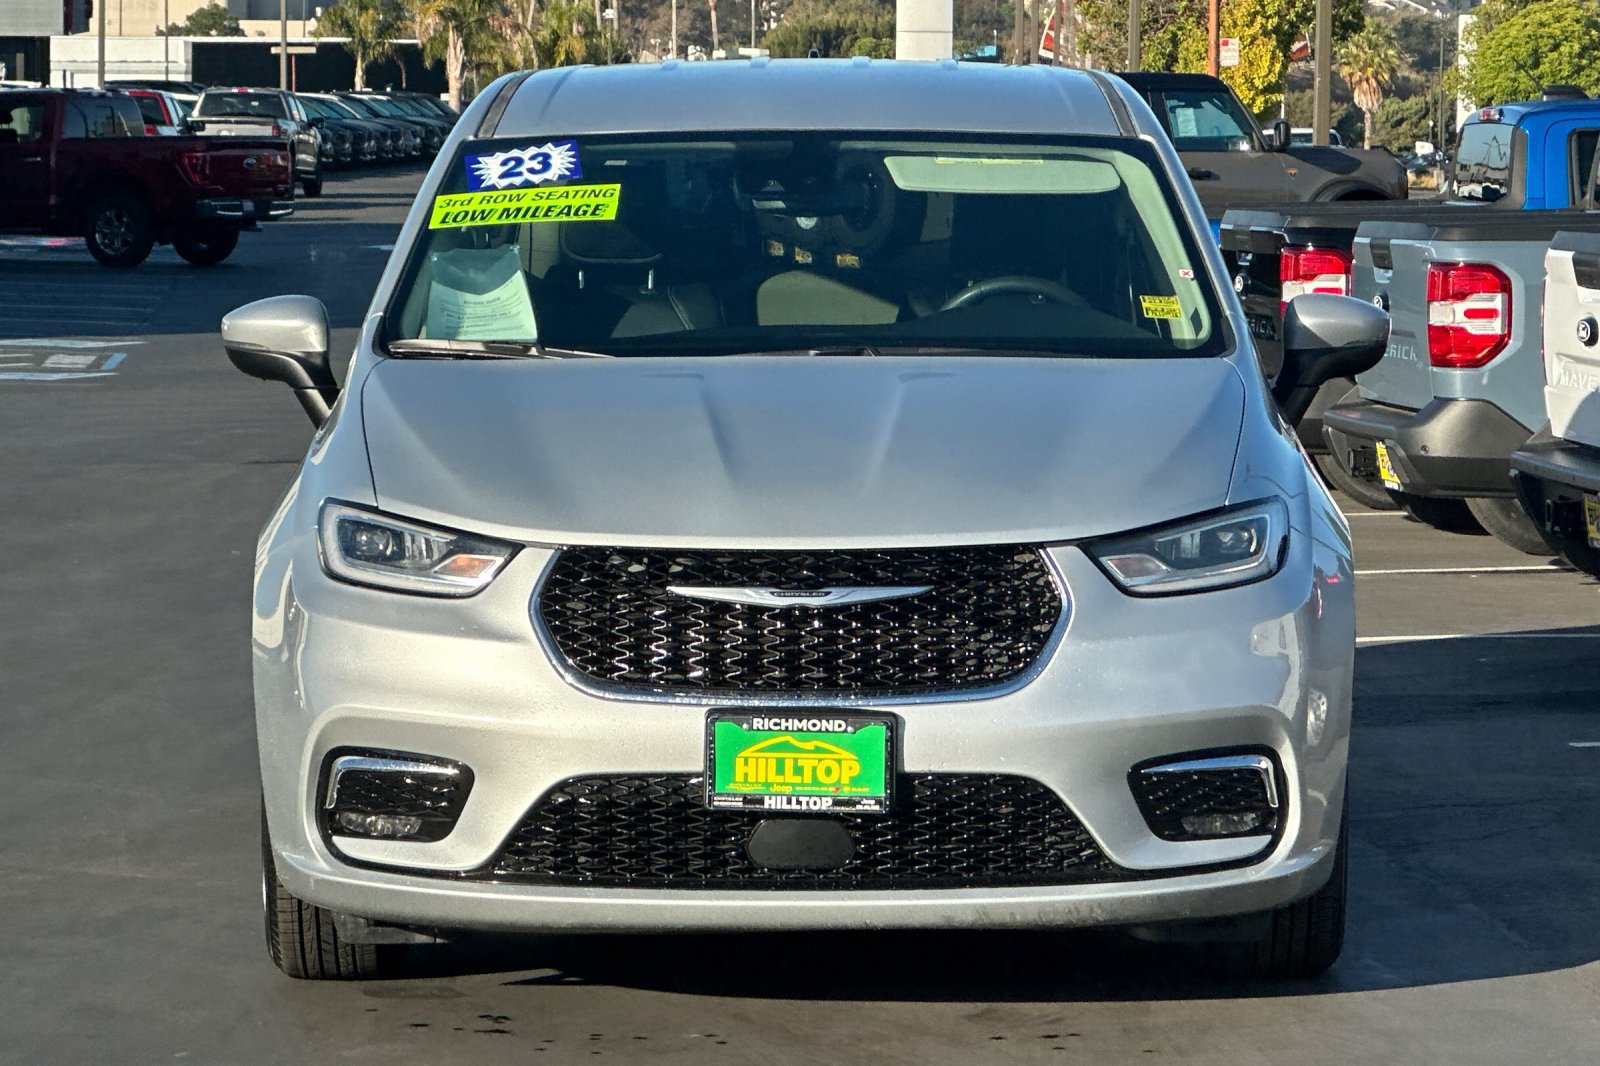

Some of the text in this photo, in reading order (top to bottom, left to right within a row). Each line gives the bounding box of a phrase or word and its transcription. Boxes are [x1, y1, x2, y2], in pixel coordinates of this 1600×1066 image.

[499, 152, 553, 179] 23
[438, 189, 616, 209] 3rd ROW SEATING
[438, 204, 606, 225] LOW MILEAGE
[752, 718, 846, 731] RICHMOND
[735, 757, 860, 784] HILLTOP
[770, 783, 793, 794] Jeep
[763, 795, 833, 810] HILLTOP
